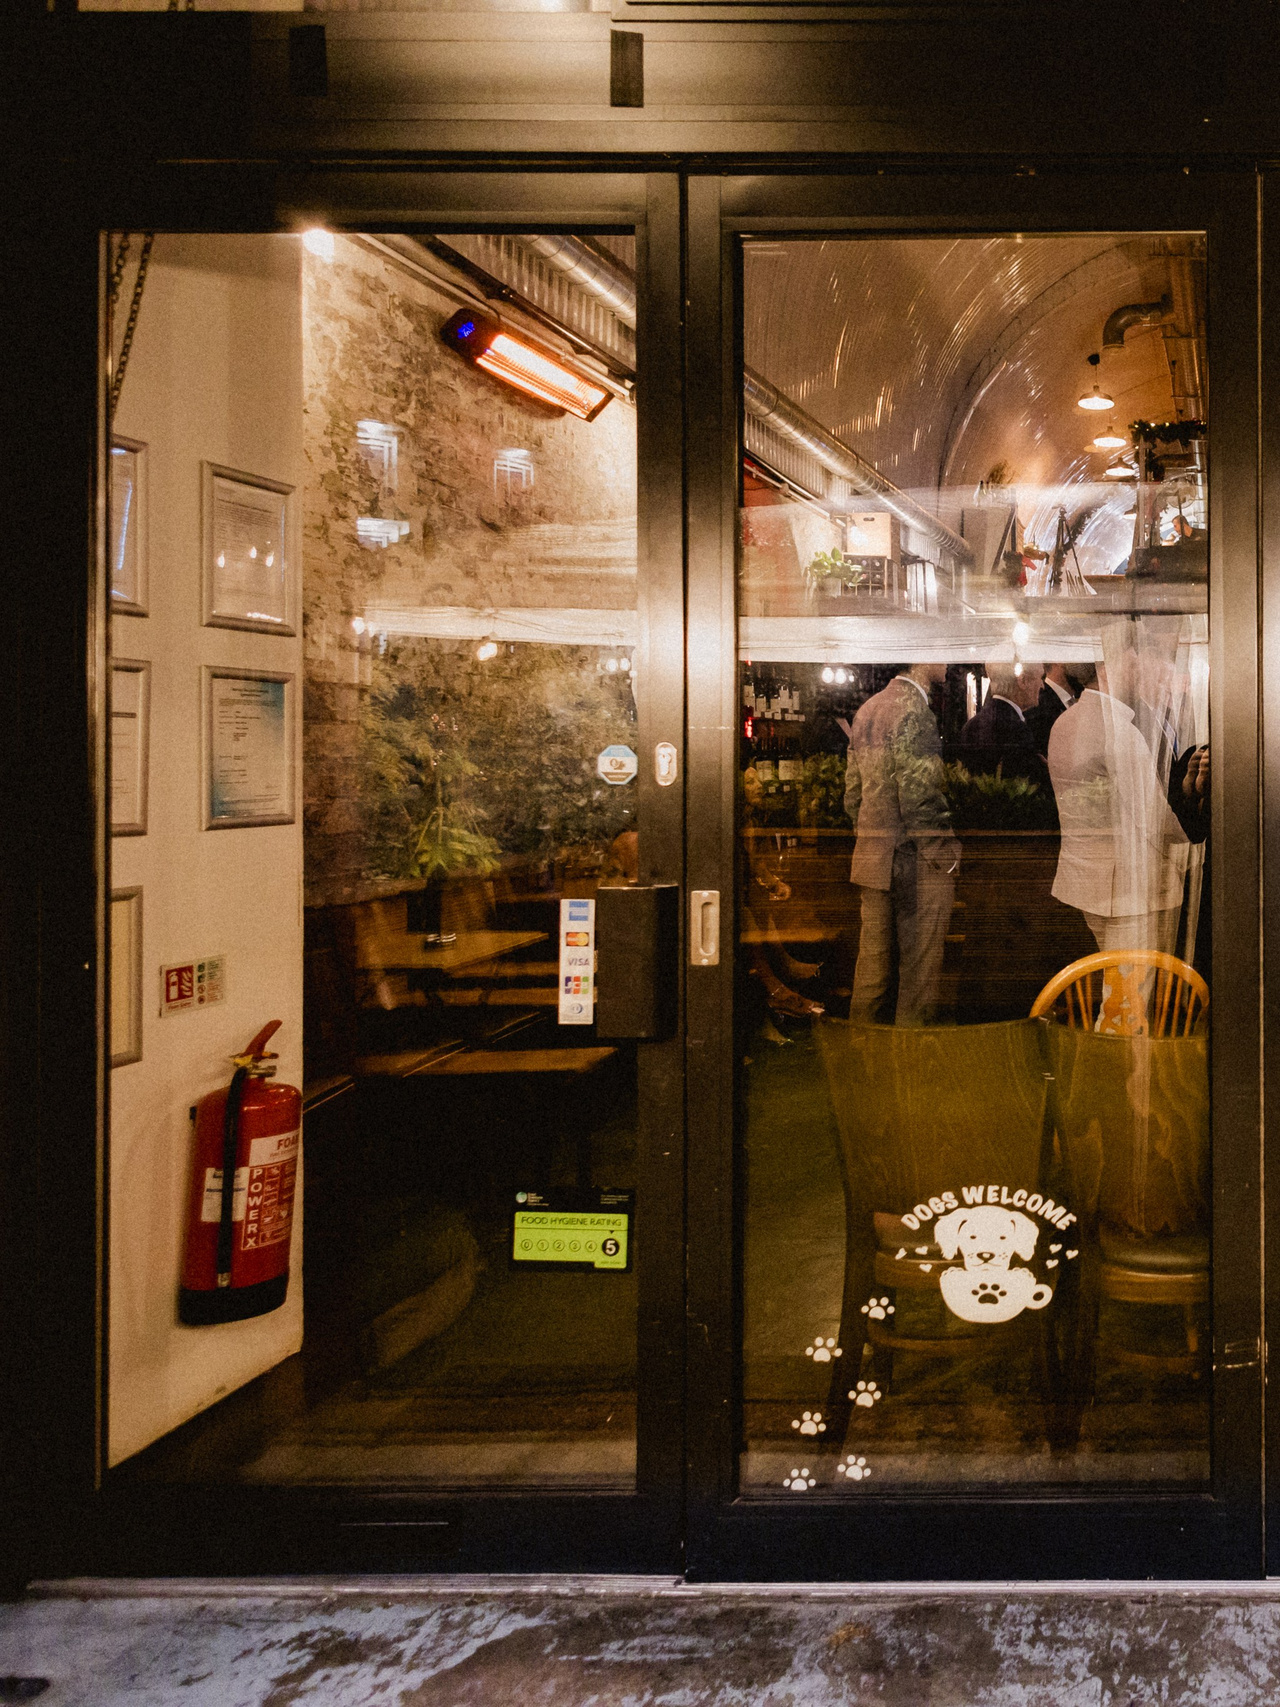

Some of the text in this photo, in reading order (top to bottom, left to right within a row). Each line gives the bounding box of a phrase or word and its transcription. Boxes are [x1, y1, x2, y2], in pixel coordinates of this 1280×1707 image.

[568, 958, 590, 967] VISA
[246, 1168, 262, 1247] POWERX
[901, 1185, 1077, 1231] DOGS WELCOME
[521, 1216, 622, 1227] FOOD HYGIENE RATING
[605, 1240, 617, 1256] 5
